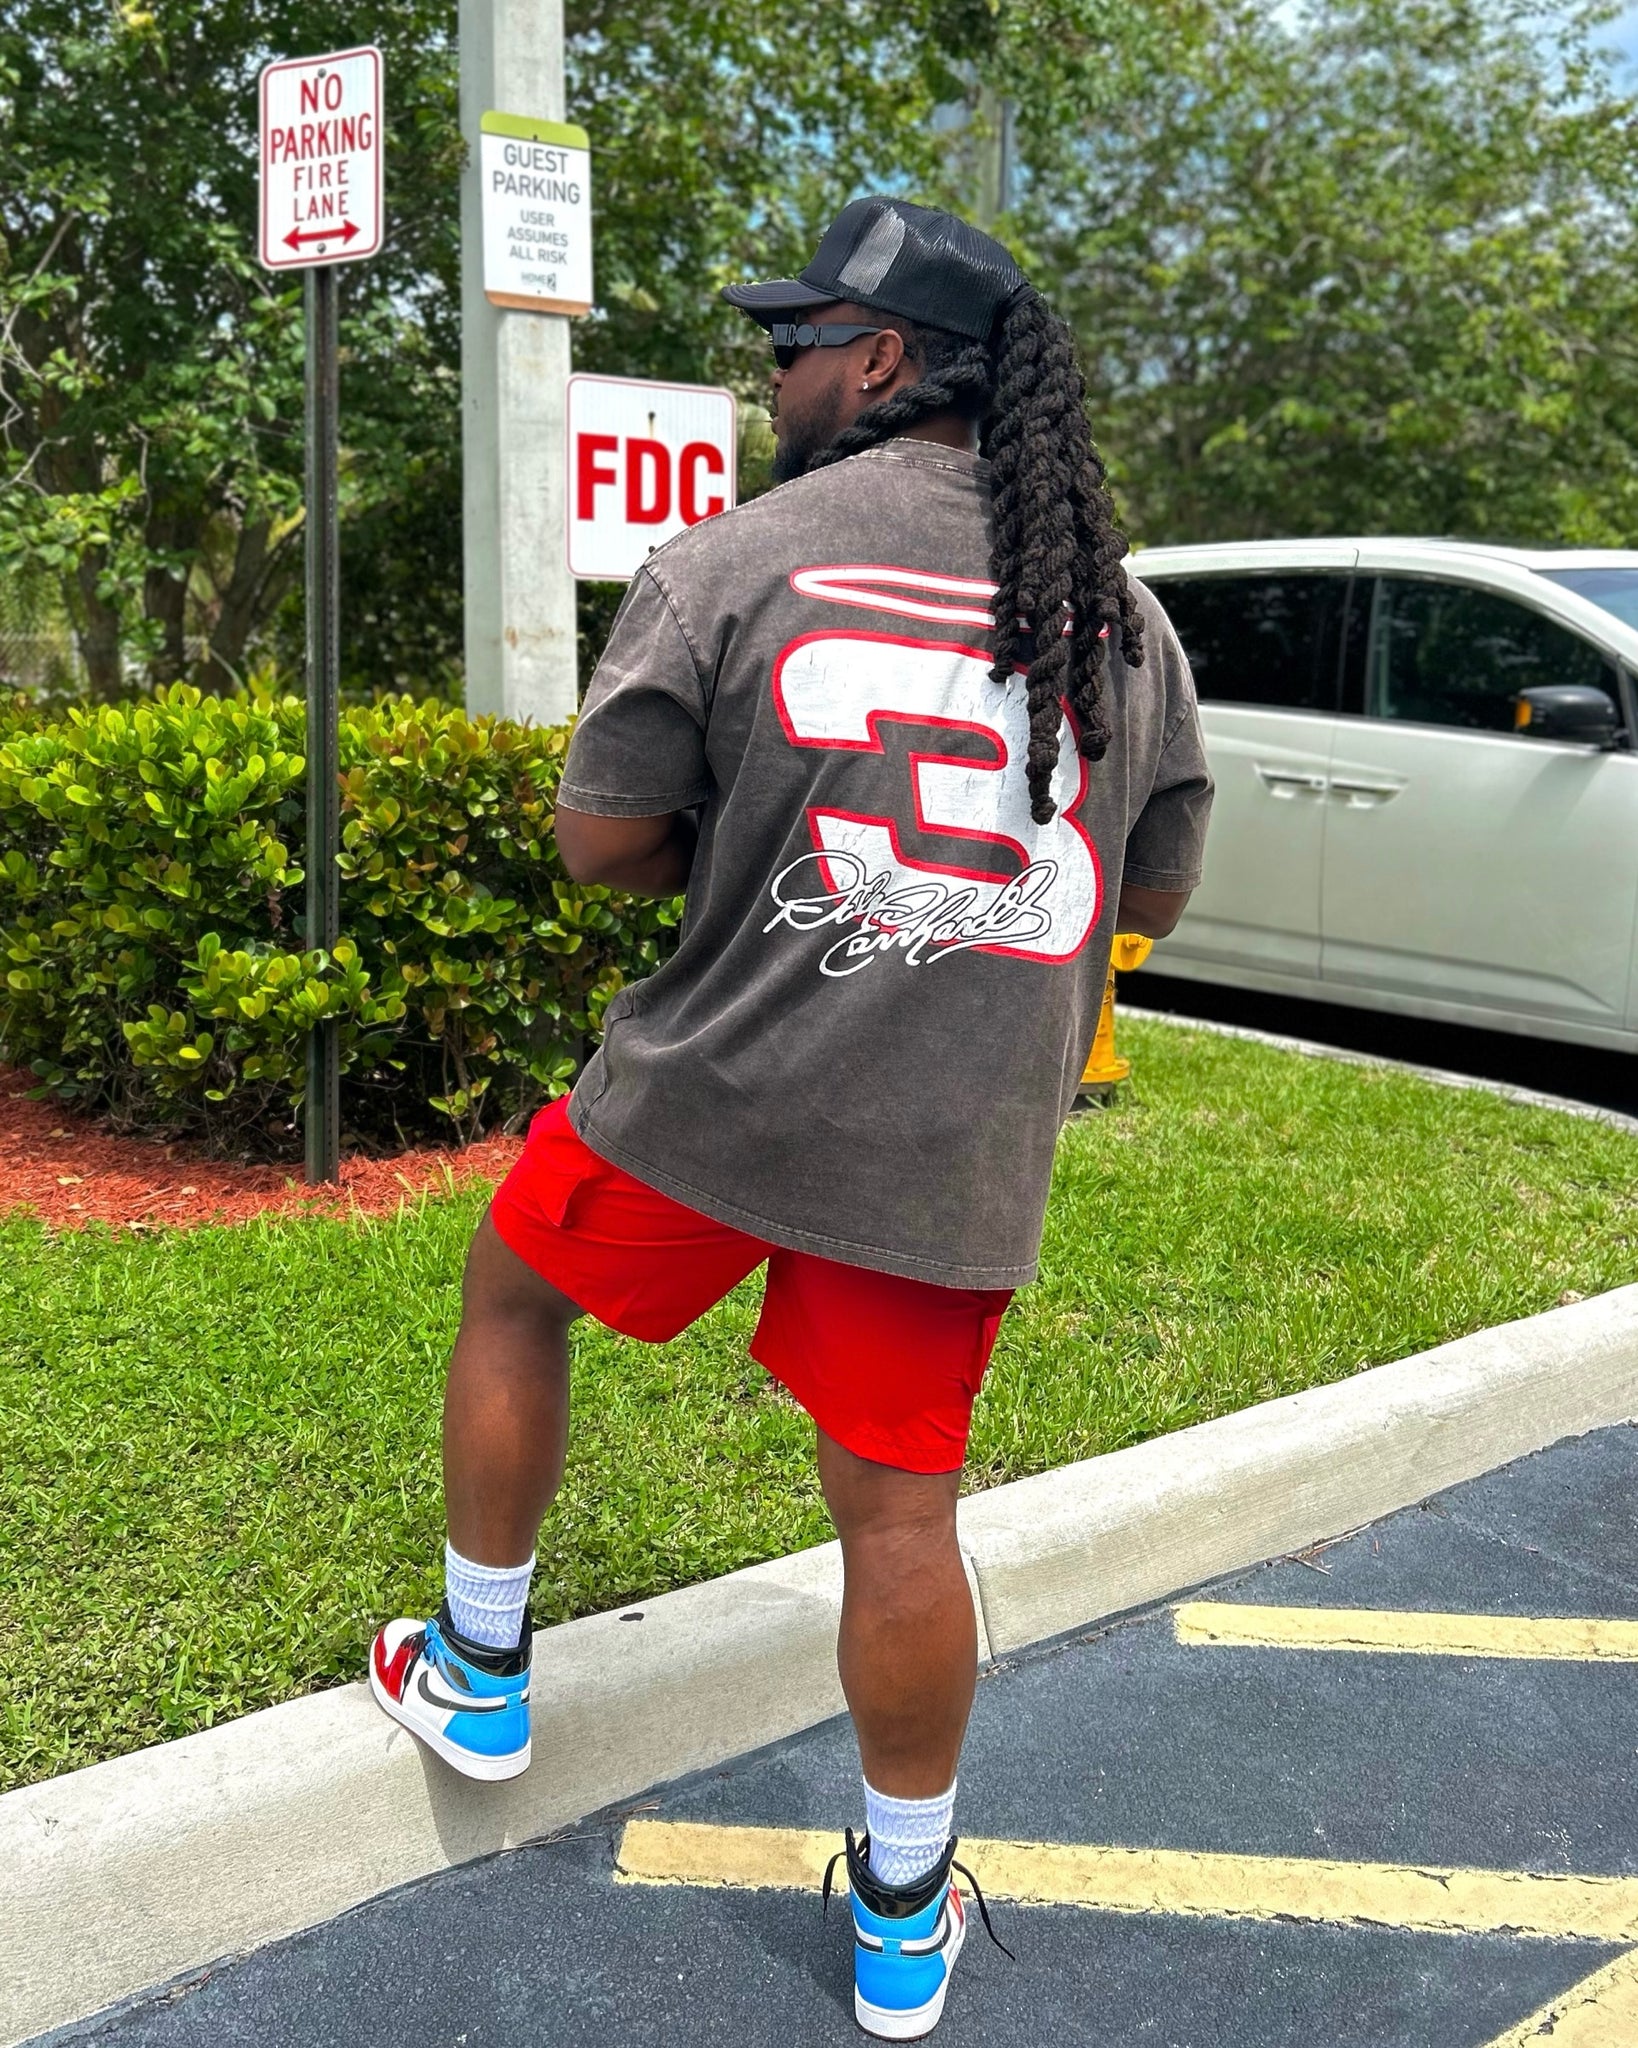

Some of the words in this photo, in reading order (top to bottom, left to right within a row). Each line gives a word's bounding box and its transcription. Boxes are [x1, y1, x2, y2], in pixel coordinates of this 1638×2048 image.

[301, 73, 343, 115] NO
[270, 112, 372, 165] PARKING
[293, 159, 349, 192] FIRE
[503, 143, 569, 175] GUEST
[492, 170, 581, 205] PARKING
[293, 190, 349, 222] LANE
[520, 209, 555, 227] USER
[507, 226, 569, 248] ASSUMES
[509, 245, 535, 261] ALL
[538, 247, 568, 265] RISK
[577, 431, 725, 528] FDC
[773, 628, 1104, 966] 3
